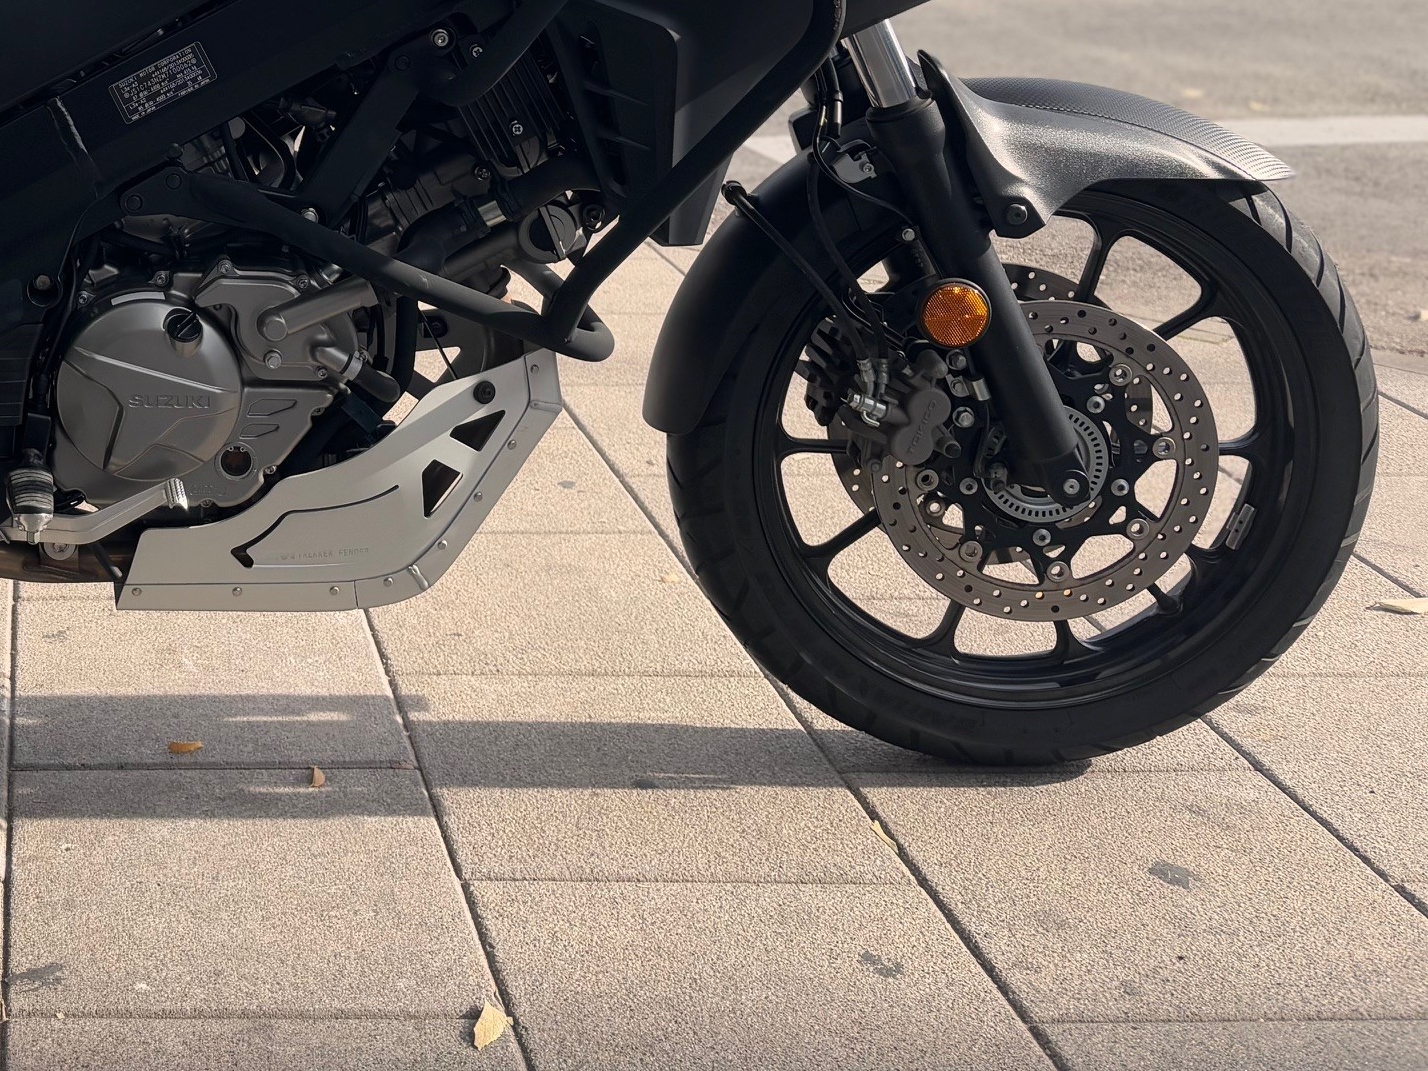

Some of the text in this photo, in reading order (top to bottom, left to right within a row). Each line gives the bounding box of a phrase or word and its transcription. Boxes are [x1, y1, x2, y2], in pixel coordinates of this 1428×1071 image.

[118, 48, 191, 88] SUZUKI MOTOR CORPORATION
[128, 394, 212, 409] SUZUKI
